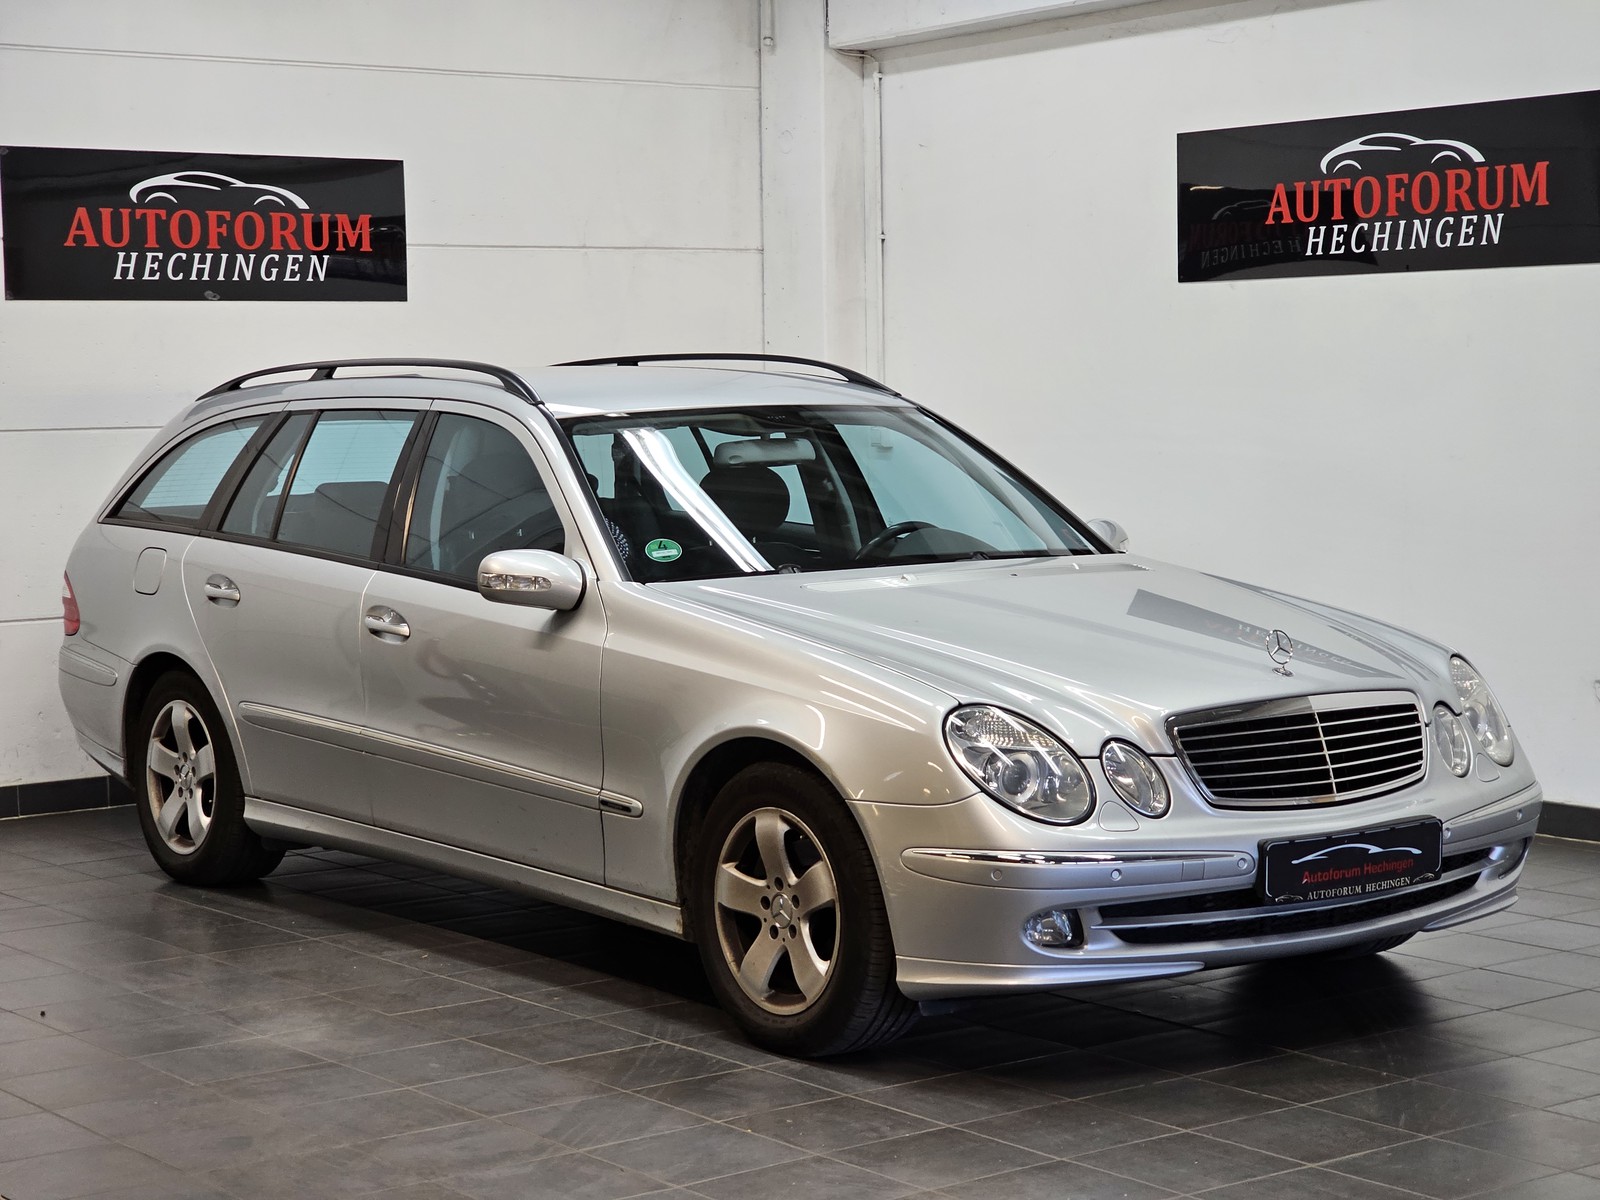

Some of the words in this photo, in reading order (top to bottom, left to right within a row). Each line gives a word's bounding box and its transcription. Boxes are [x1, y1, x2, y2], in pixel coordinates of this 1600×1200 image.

[1306, 161, 1549, 225] AUTOFORUM
[64, 207, 373, 252] AUTOFORUM
[1305, 213, 1505, 256] HECHINGEN
[113, 252, 330, 282] HECHINGEN
[1302, 866, 1361, 884] Autoforum
[1364, 858, 1414, 875] Hechingen
[1307, 886, 1362, 900] AUTOFORUM
[1366, 877, 1411, 892] HECHINGEN
